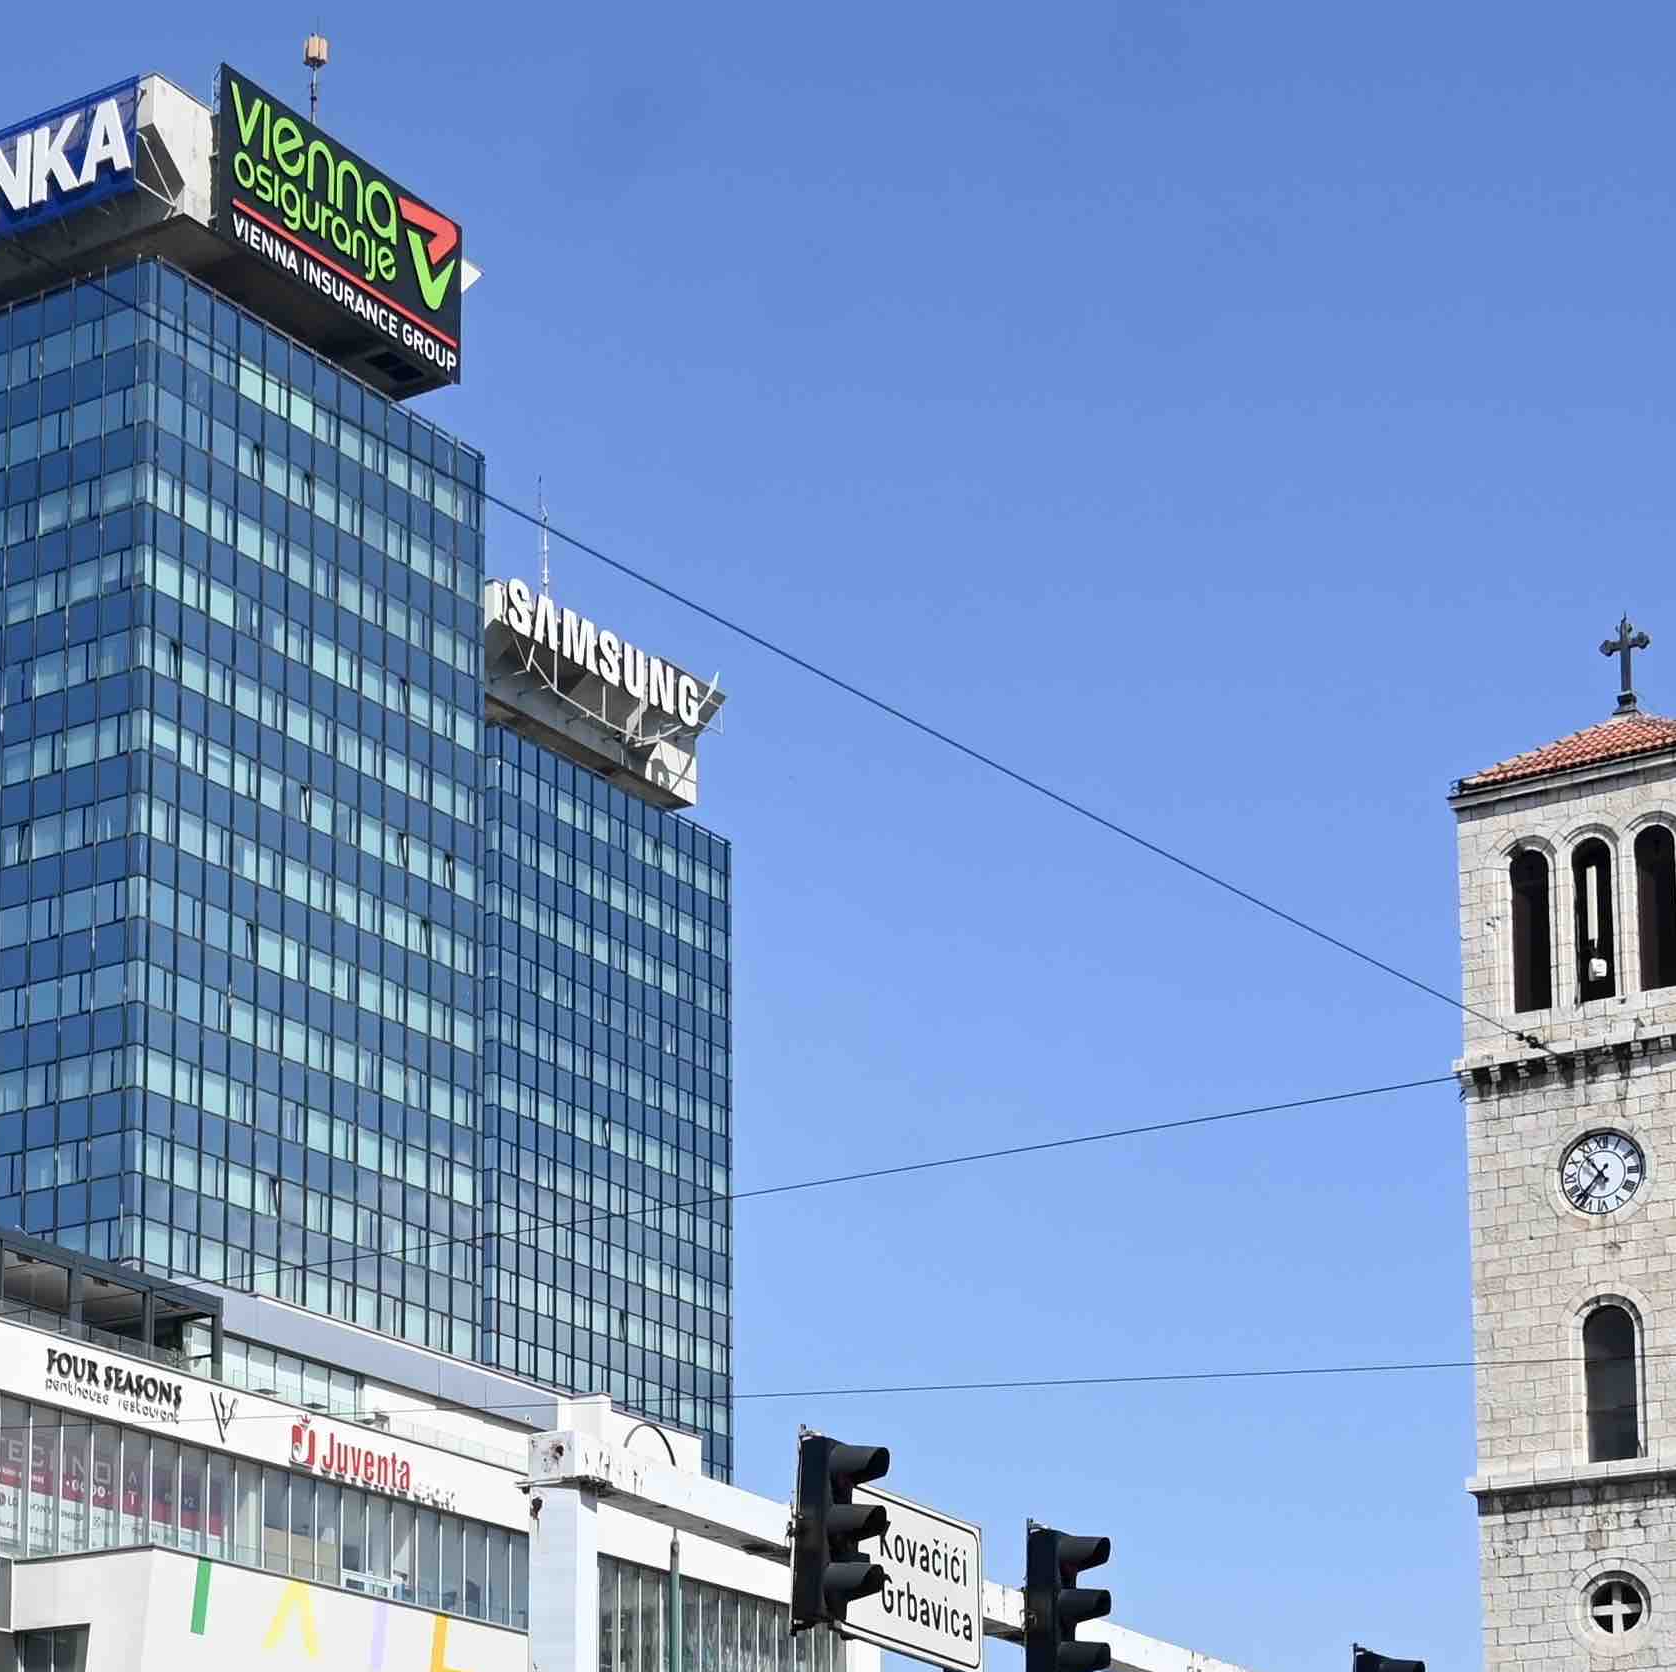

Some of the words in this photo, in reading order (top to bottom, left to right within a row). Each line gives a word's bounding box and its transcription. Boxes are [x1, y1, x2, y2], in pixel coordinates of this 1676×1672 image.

[234, 151, 396, 282] osiguranje
[233, 213, 299, 275] VIENNA
[303, 257, 398, 338] INSURANCE
[402, 325, 457, 371] GROUP
[507, 578, 699, 727] SAMSUNG
[47, 1348, 99, 1386] FOUR
[103, 1366, 182, 1408] SEASONS
[323, 1433, 410, 1489] Juventa
[880, 1534, 967, 1587] Kovačići
[882, 1571, 972, 1642] Grbavica
